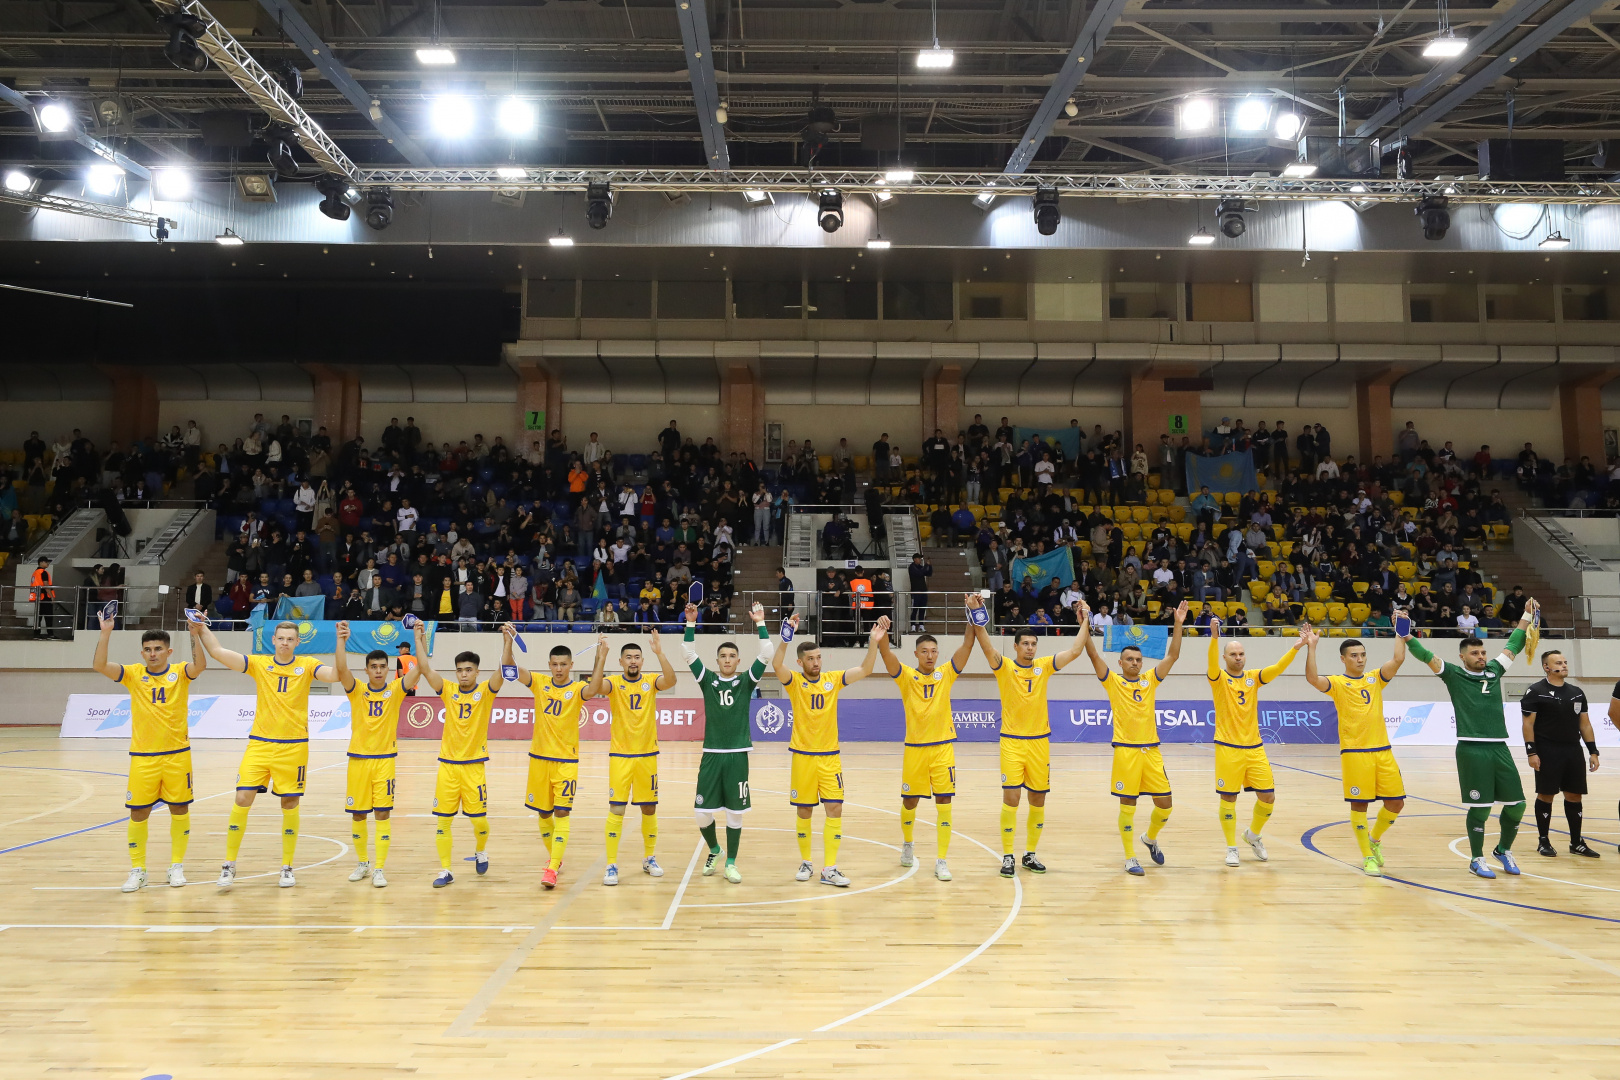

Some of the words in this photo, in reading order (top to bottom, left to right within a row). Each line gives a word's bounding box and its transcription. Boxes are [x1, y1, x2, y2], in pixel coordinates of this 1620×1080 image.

[531, 411, 539, 425] 7
[1174, 415, 1183, 429] 8
[277, 676, 288, 693] 11
[923, 684, 935, 699] 17
[1024, 679, 1032, 693] 7
[1479, 679, 1490, 694] 2
[151, 687, 166, 704] 14
[629, 693, 642, 710] 12
[718, 689, 734, 706] 16
[810, 693, 825, 710] 10
[1132, 689, 1143, 702] 6
[1237, 690, 1246, 705] 3
[1360, 689, 1371, 705] 9
[86, 707, 111, 717] Sport
[237, 708, 255, 718] Spo
[309, 709, 333, 719] Sport
[334, 710, 351, 718] Qor
[368, 700, 383, 717] 18
[458, 703, 472, 719] 13
[543, 698, 563, 716] 20
[296, 765, 306, 783] 11
[561, 779, 577, 797] 20
[737, 780, 749, 799] 16
